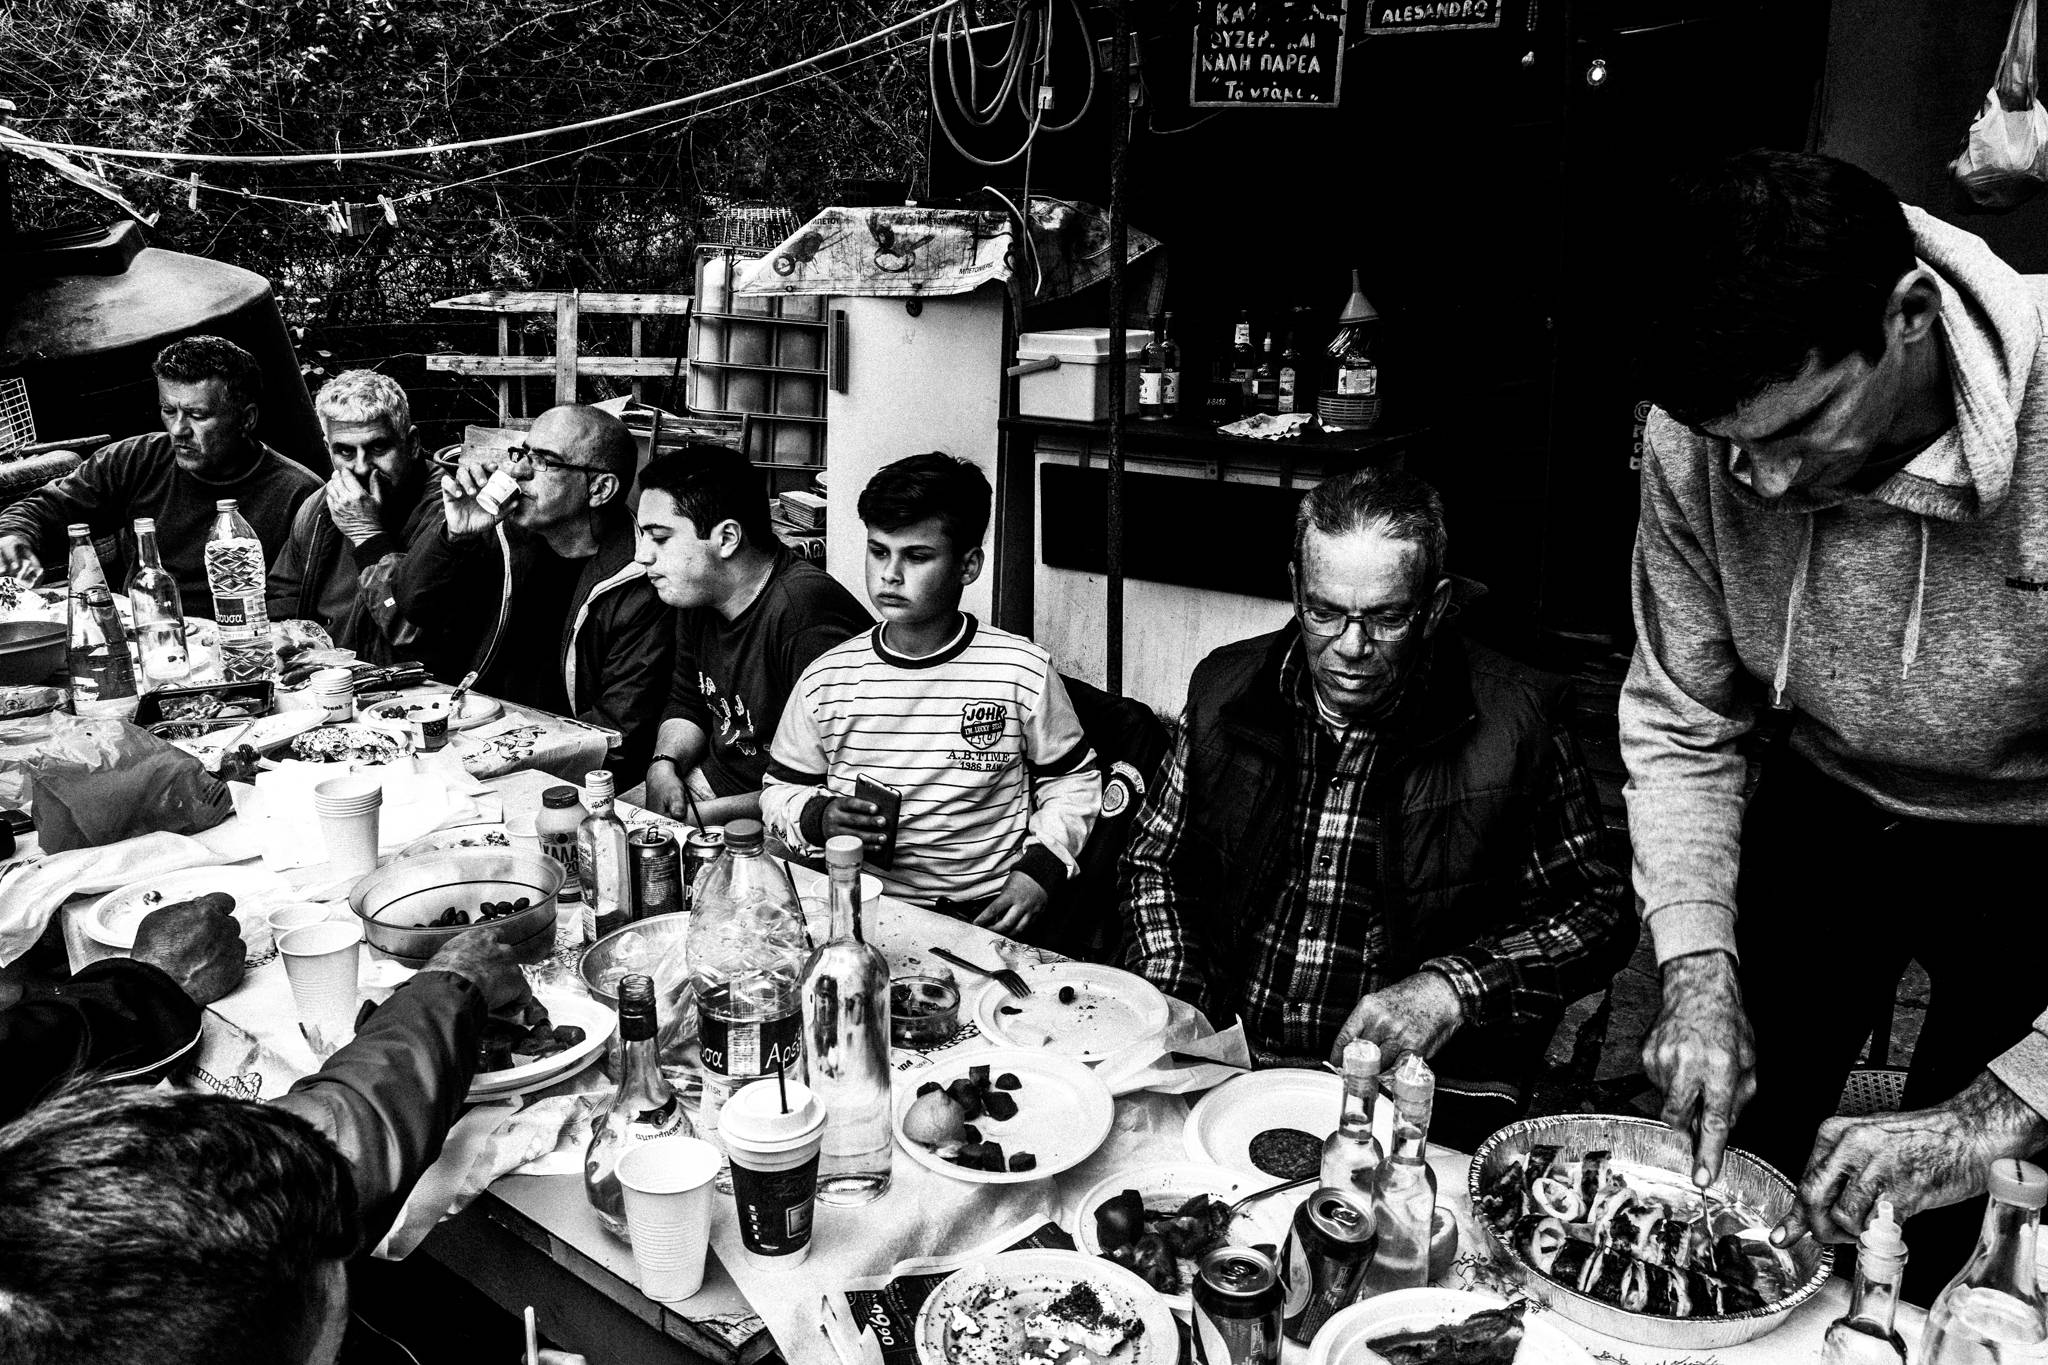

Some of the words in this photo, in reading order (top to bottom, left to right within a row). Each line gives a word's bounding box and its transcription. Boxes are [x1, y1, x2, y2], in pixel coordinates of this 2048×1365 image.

[1381, 0, 1489, 24] ALESANDRO
[1202, 53, 1251, 73] ΚΑΛΗ
[1260, 54, 1321, 74] ΠΑΡΕΑ
